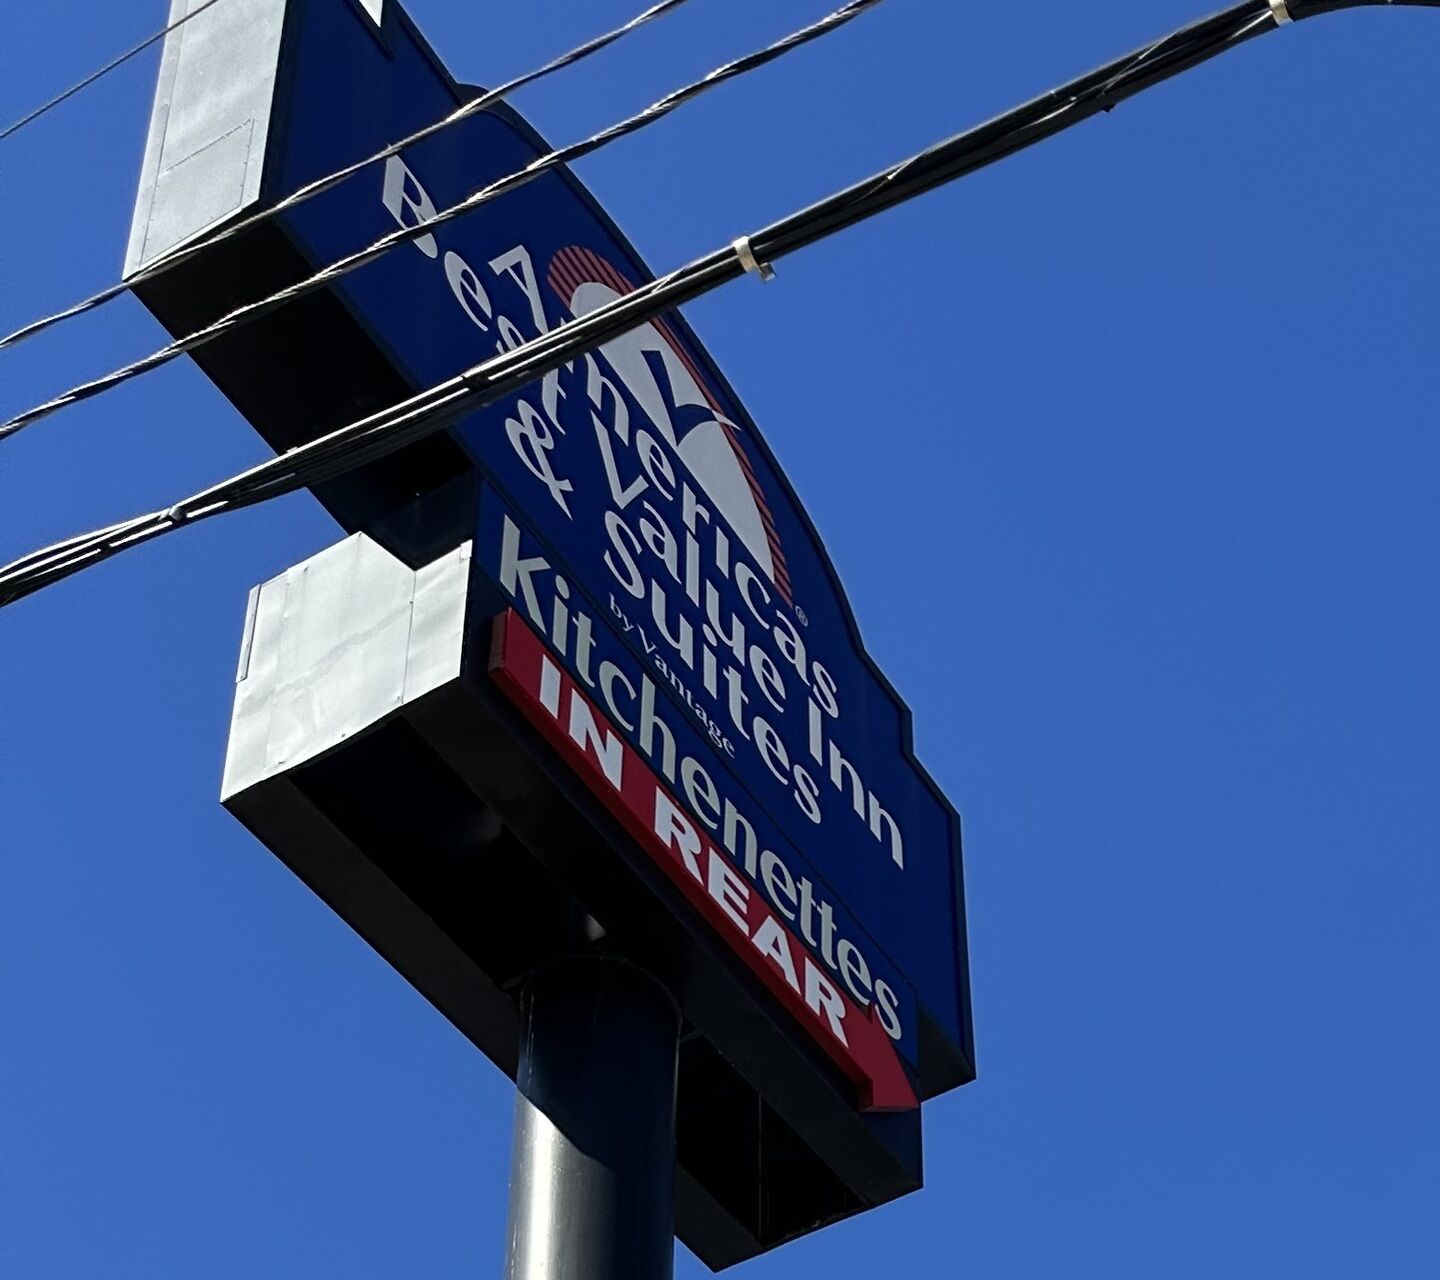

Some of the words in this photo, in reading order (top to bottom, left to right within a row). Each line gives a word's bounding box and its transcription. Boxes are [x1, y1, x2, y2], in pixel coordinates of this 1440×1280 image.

[488, 244, 839, 719] Americas
[505, 399, 573, 519] &
[604, 511, 821, 824] Suites
[589, 409, 786, 714] Value
[809, 697, 904, 870] Inn
[609, 592, 634, 631] by
[637, 624, 735, 758] Vantage
[500, 514, 901, 1040] Kitchenettes
[539, 655, 623, 791] IN
[654, 787, 849, 1048] REAR
